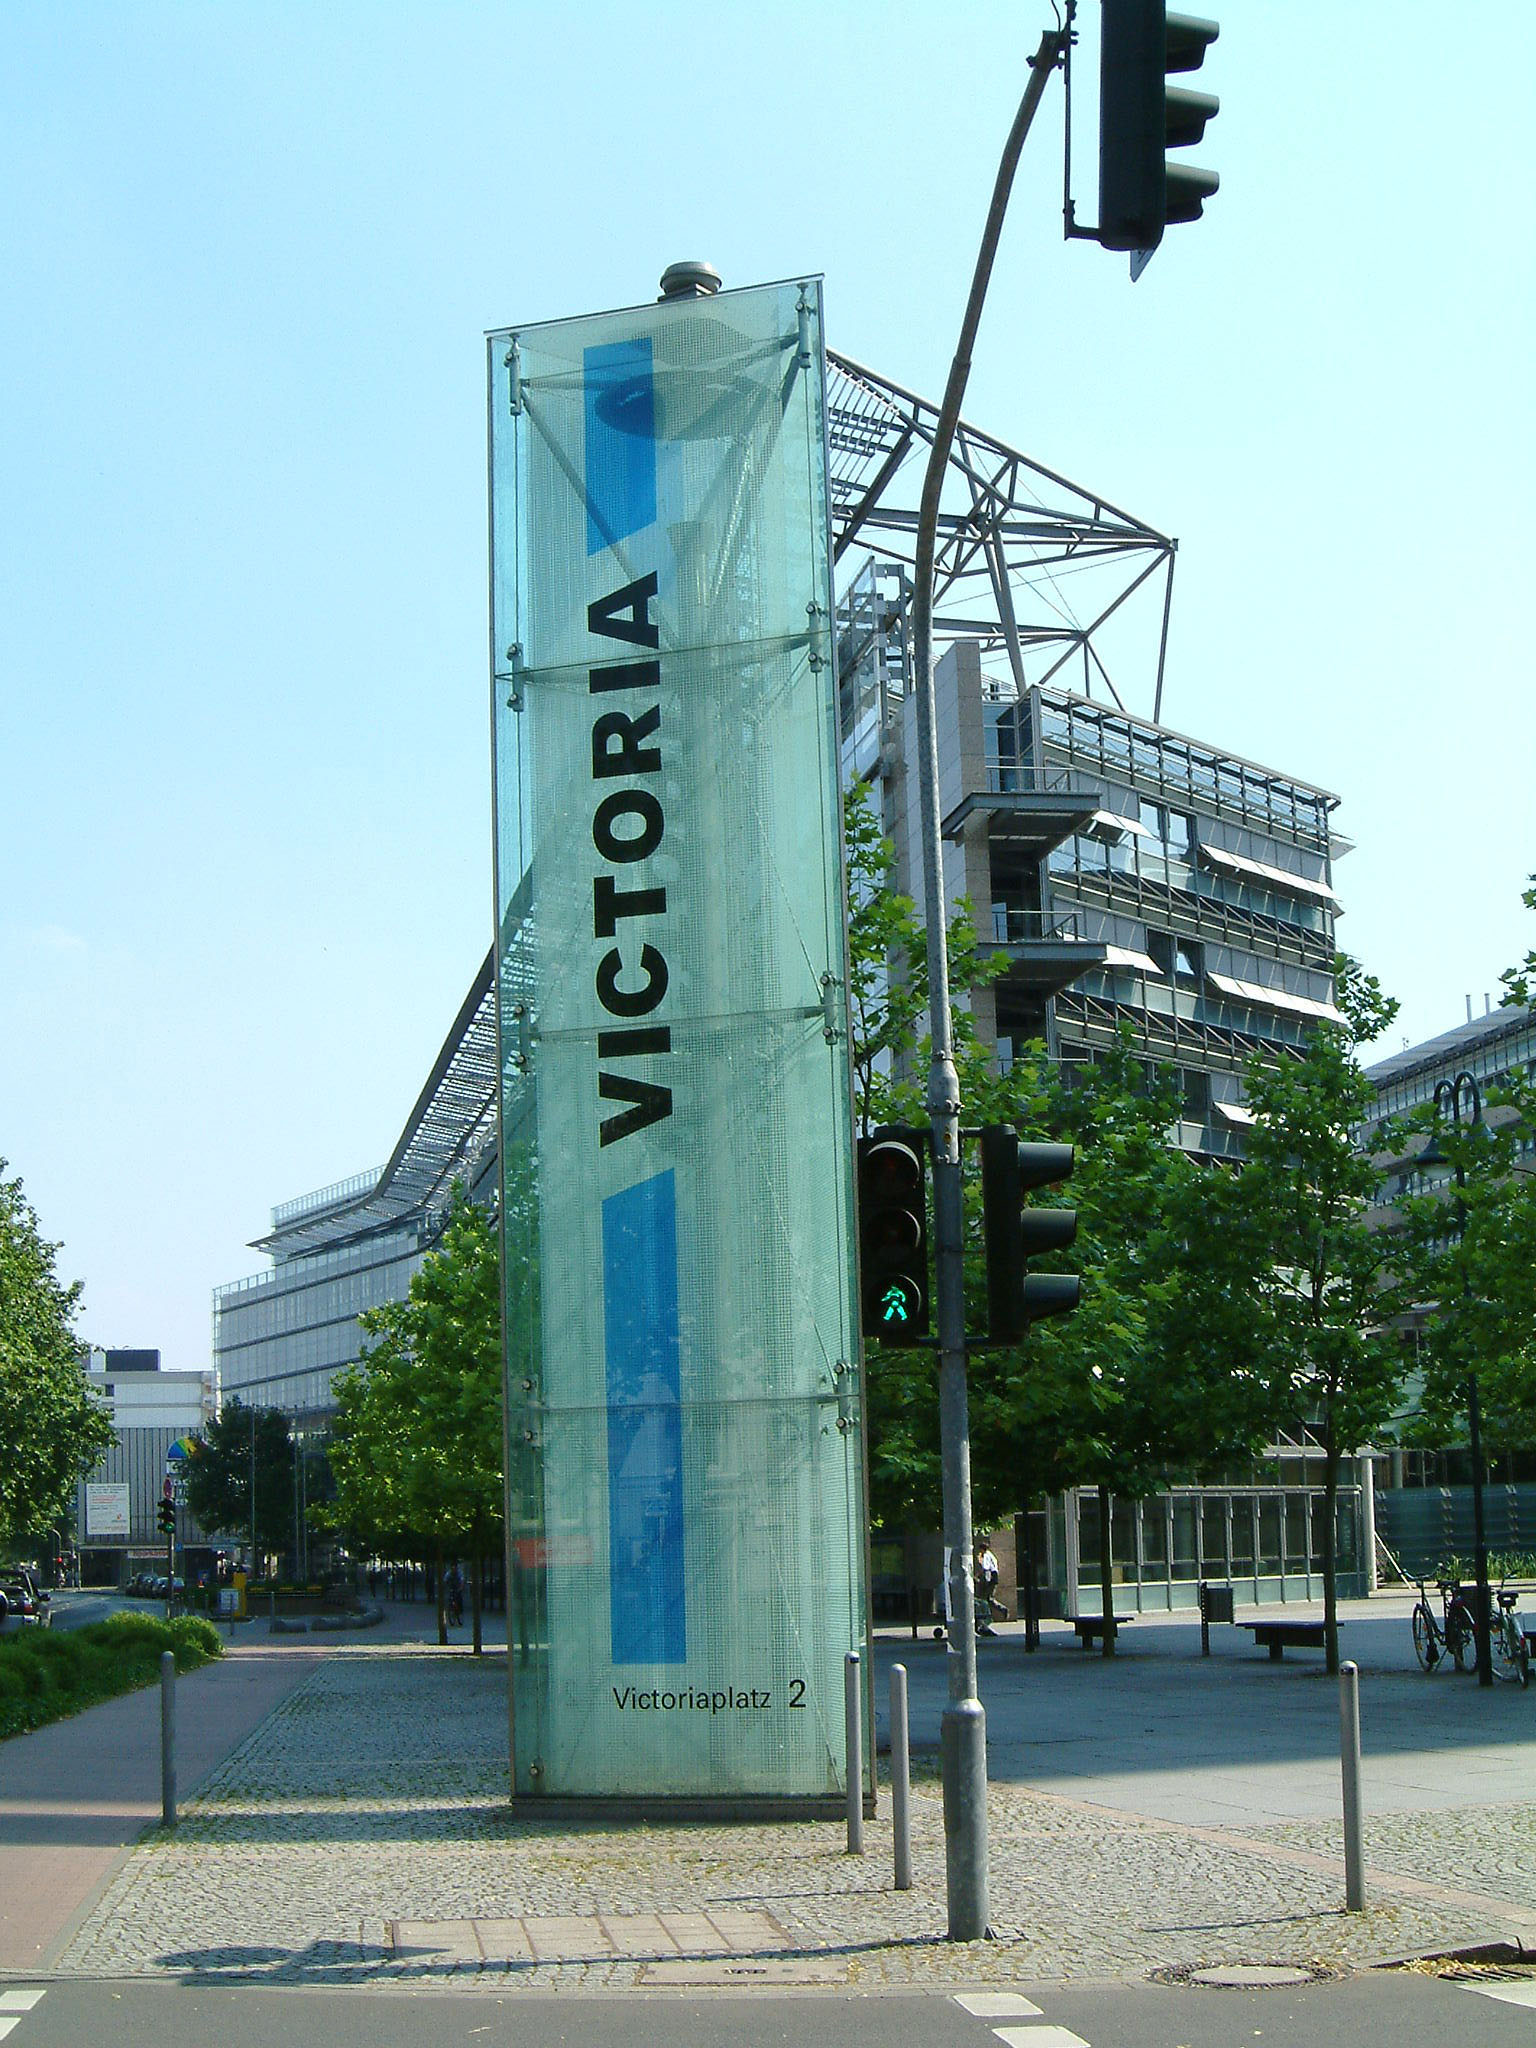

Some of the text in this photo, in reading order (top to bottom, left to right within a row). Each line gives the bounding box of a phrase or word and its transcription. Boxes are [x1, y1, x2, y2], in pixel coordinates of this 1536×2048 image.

[588, 570, 673, 1147] VICTORIA
[613, 1679, 806, 1714] Victoriaplatz 2
